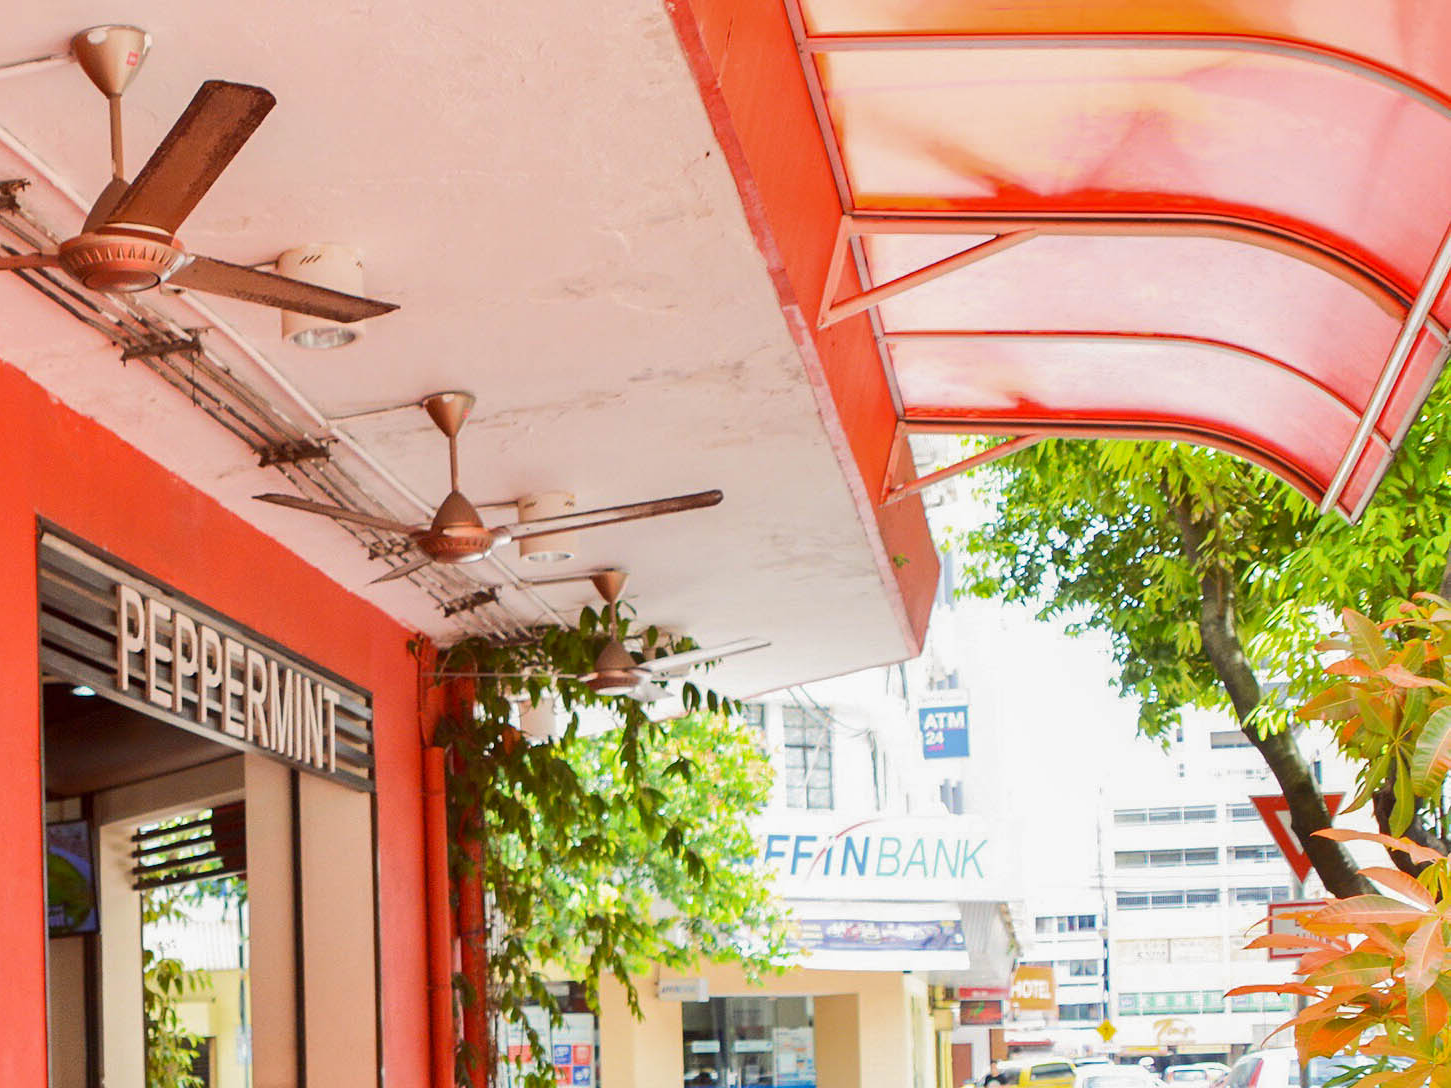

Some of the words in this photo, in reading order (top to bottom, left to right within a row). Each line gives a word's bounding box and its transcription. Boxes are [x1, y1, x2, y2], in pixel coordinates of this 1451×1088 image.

[117, 584, 340, 773] PEPPERMINT
[924, 711, 965, 729] ATM
[925, 731, 945, 745] 24
[875, 837, 988, 878] BANK
[1012, 980, 1051, 998] HOTEL
